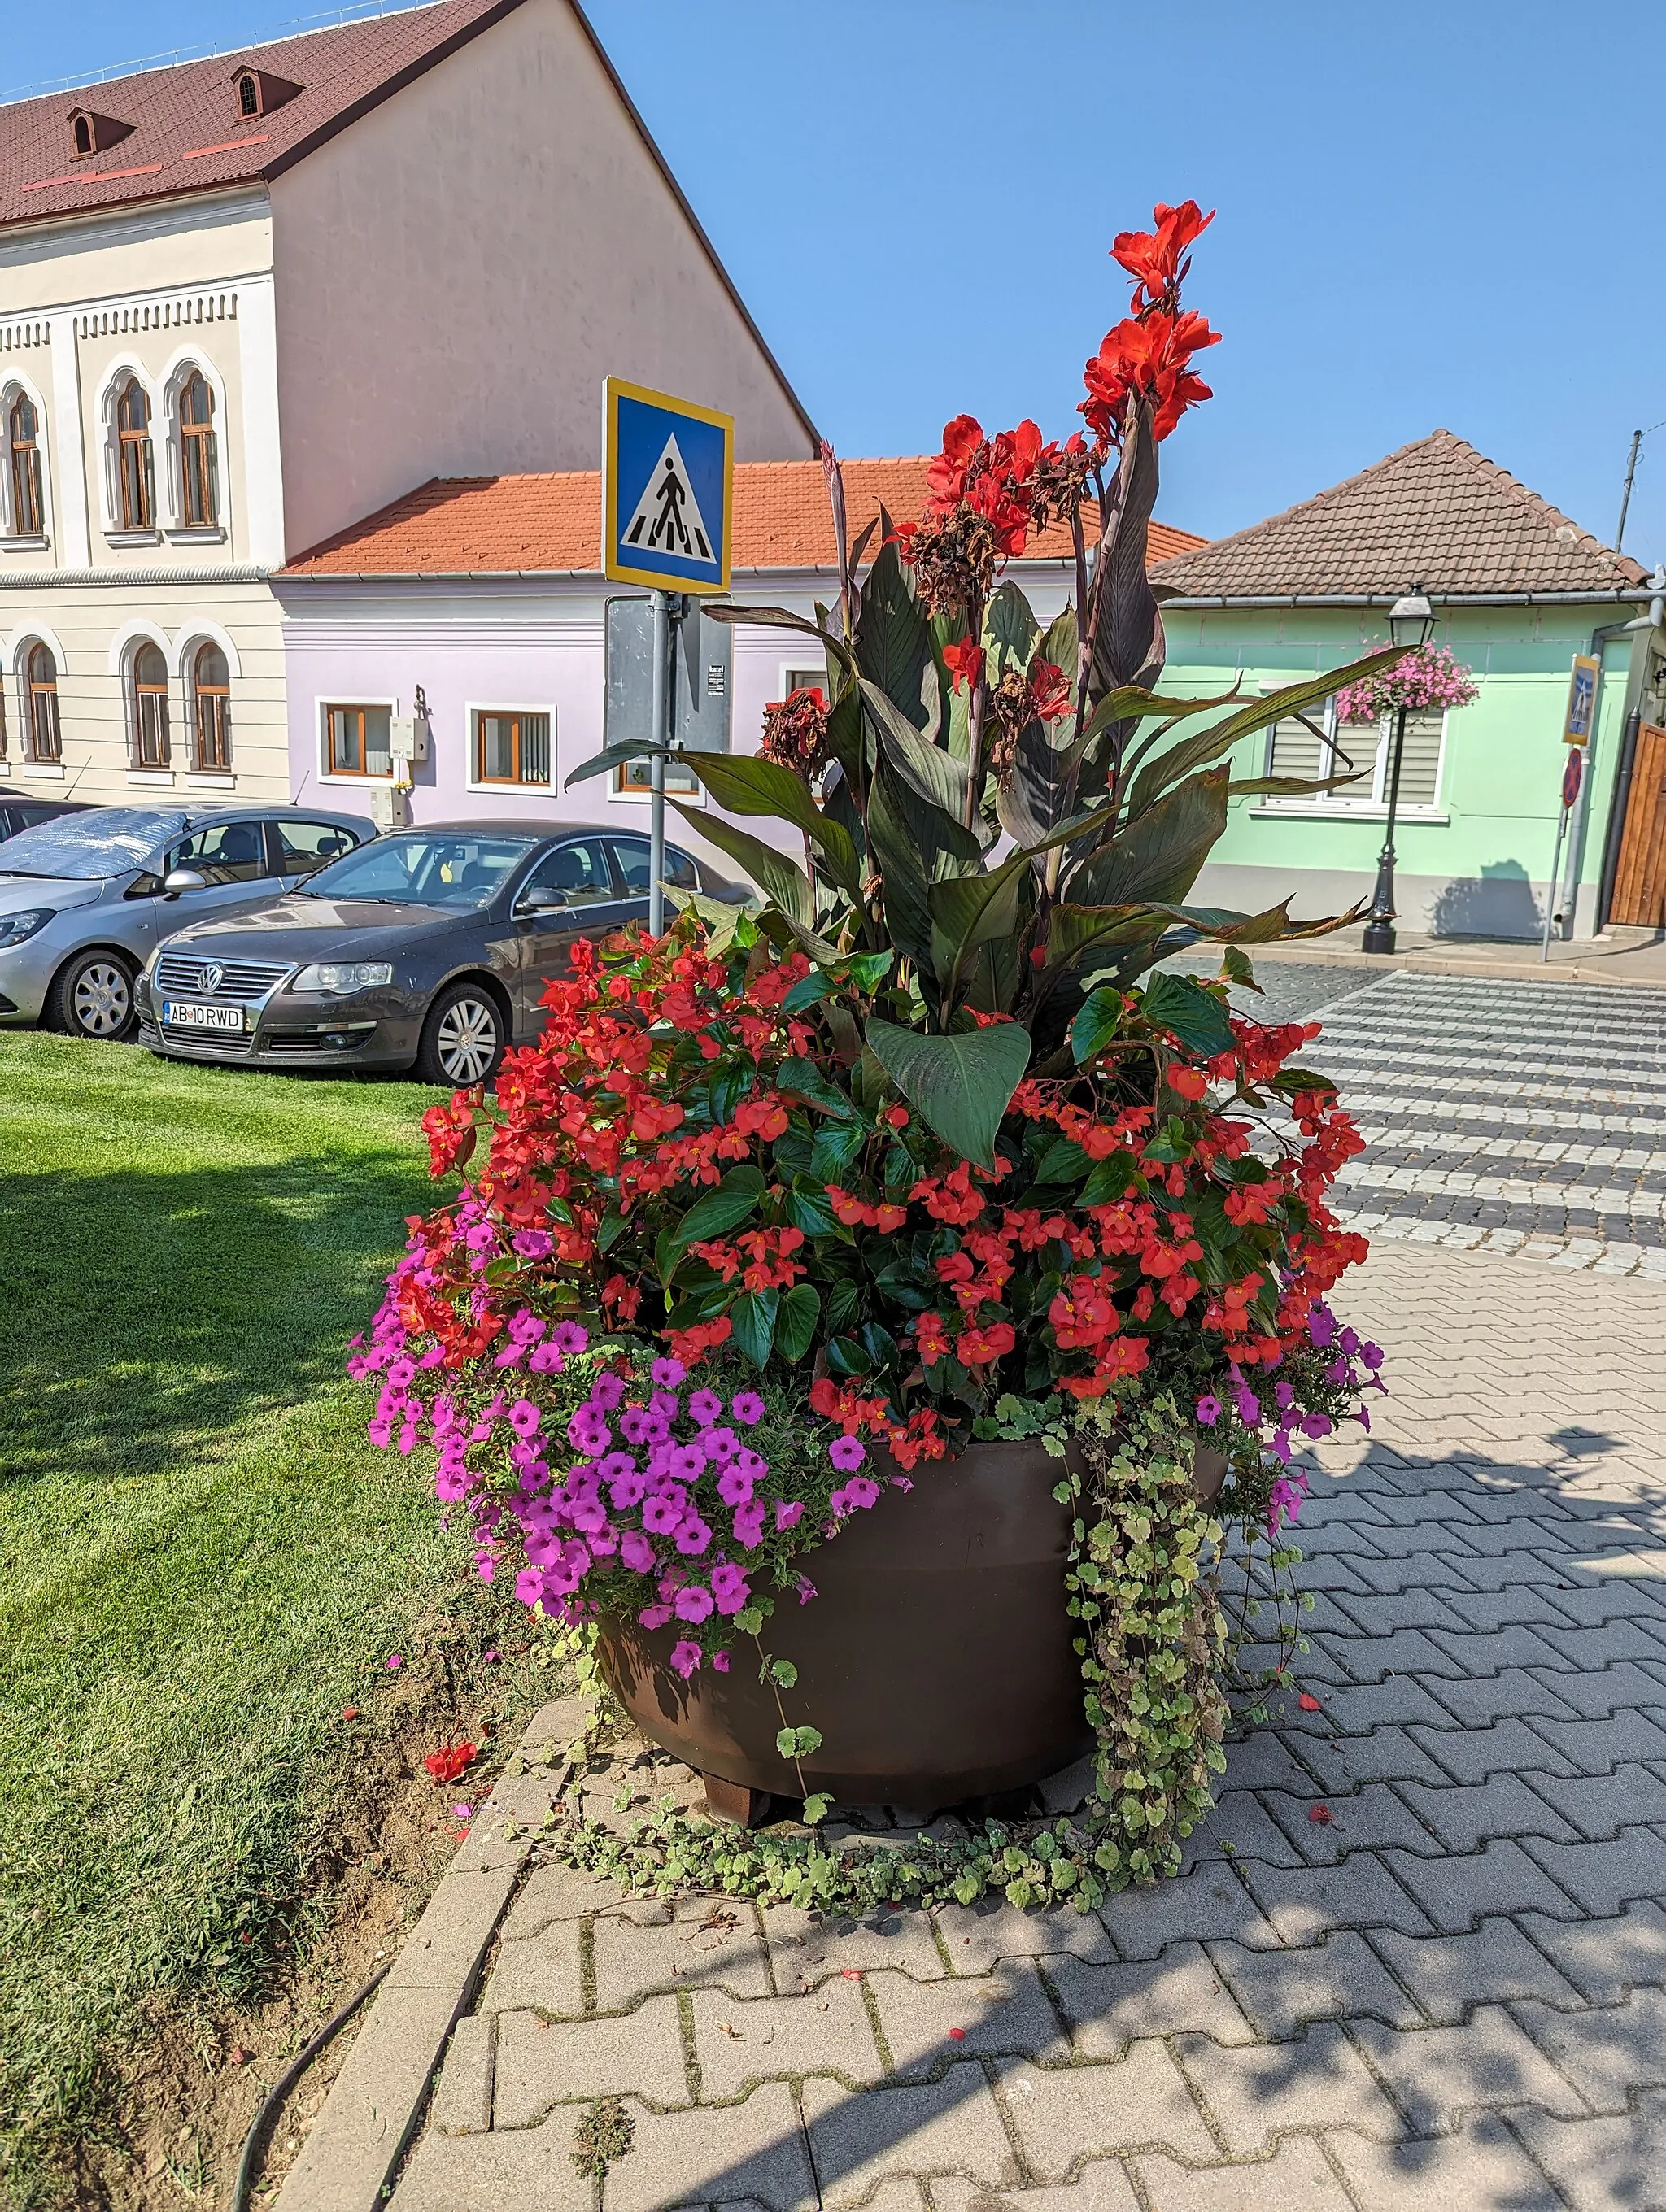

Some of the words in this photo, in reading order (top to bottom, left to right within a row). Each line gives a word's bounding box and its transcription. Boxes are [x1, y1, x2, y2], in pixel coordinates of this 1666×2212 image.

[172, 1005, 187, 1022] AB
[193, 1007, 204, 1024] 10
[207, 1008, 239, 1027] RWD
